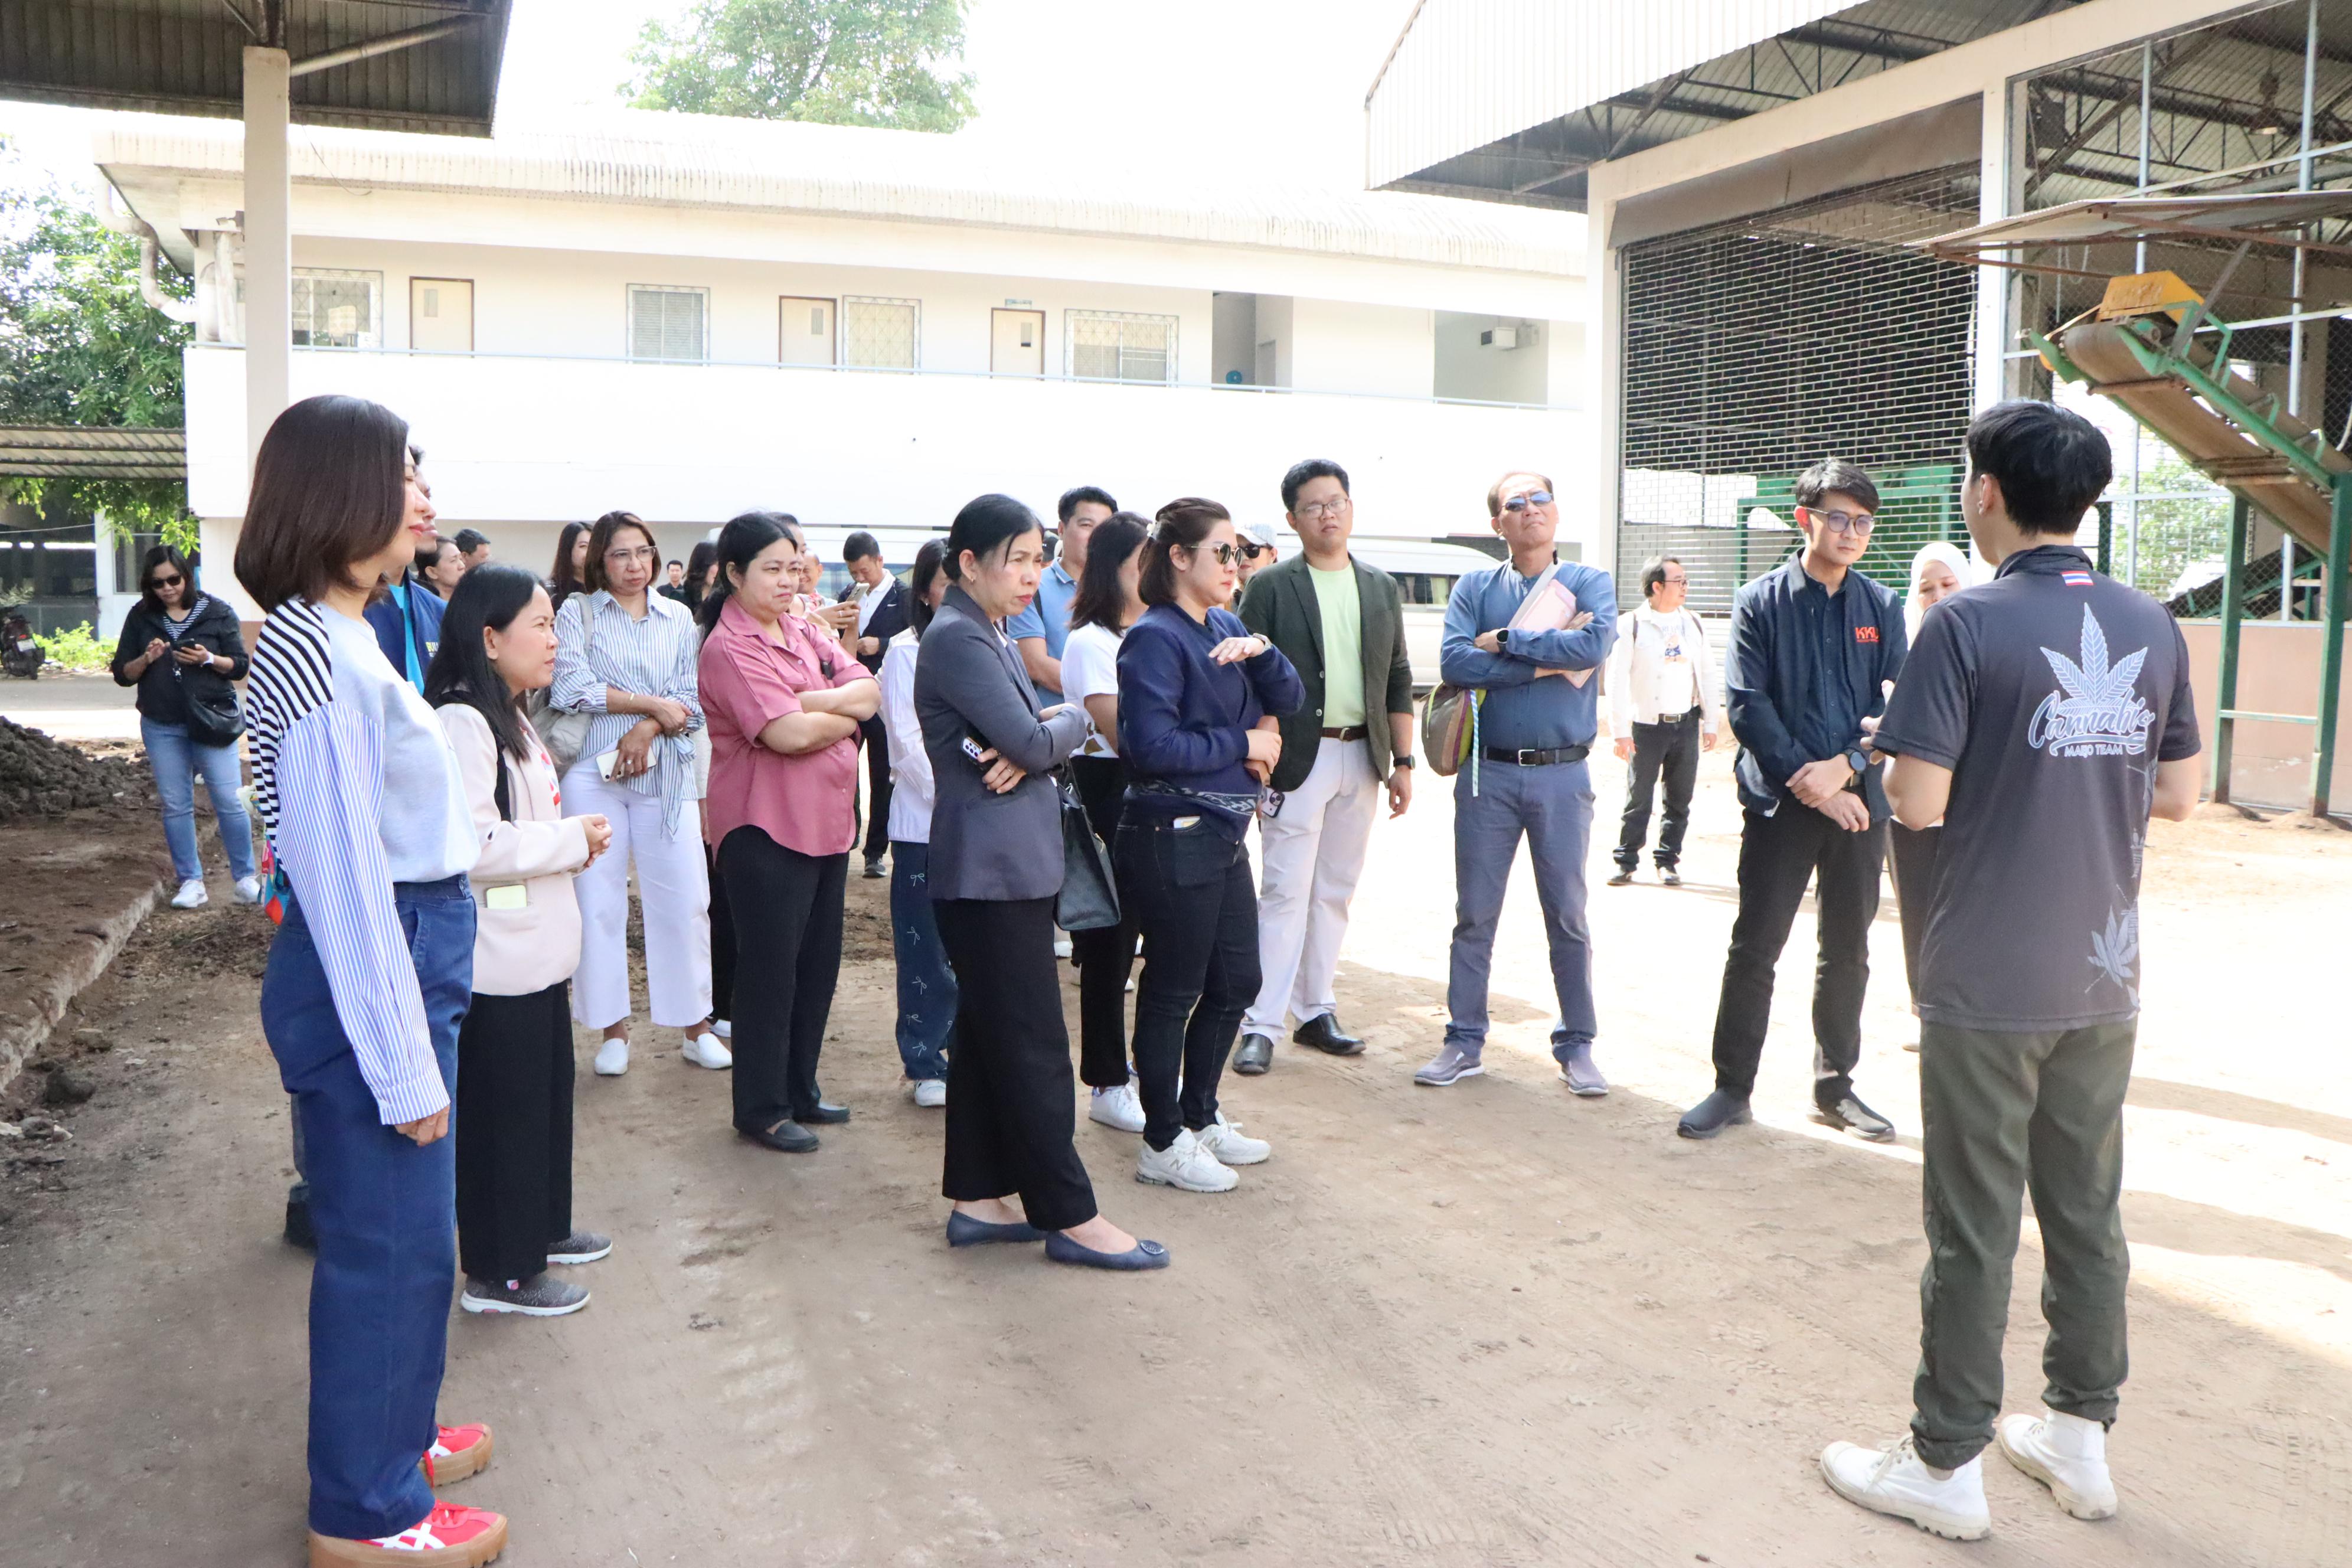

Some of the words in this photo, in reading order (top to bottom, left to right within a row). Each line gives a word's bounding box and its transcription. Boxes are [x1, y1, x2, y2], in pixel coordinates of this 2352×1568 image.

[2028, 687, 2155, 749] Cannabis
[2095, 744, 2124, 756] TEAM
[1208, 1137, 1223, 1148] N
[1170, 1158, 1185, 1171] N
